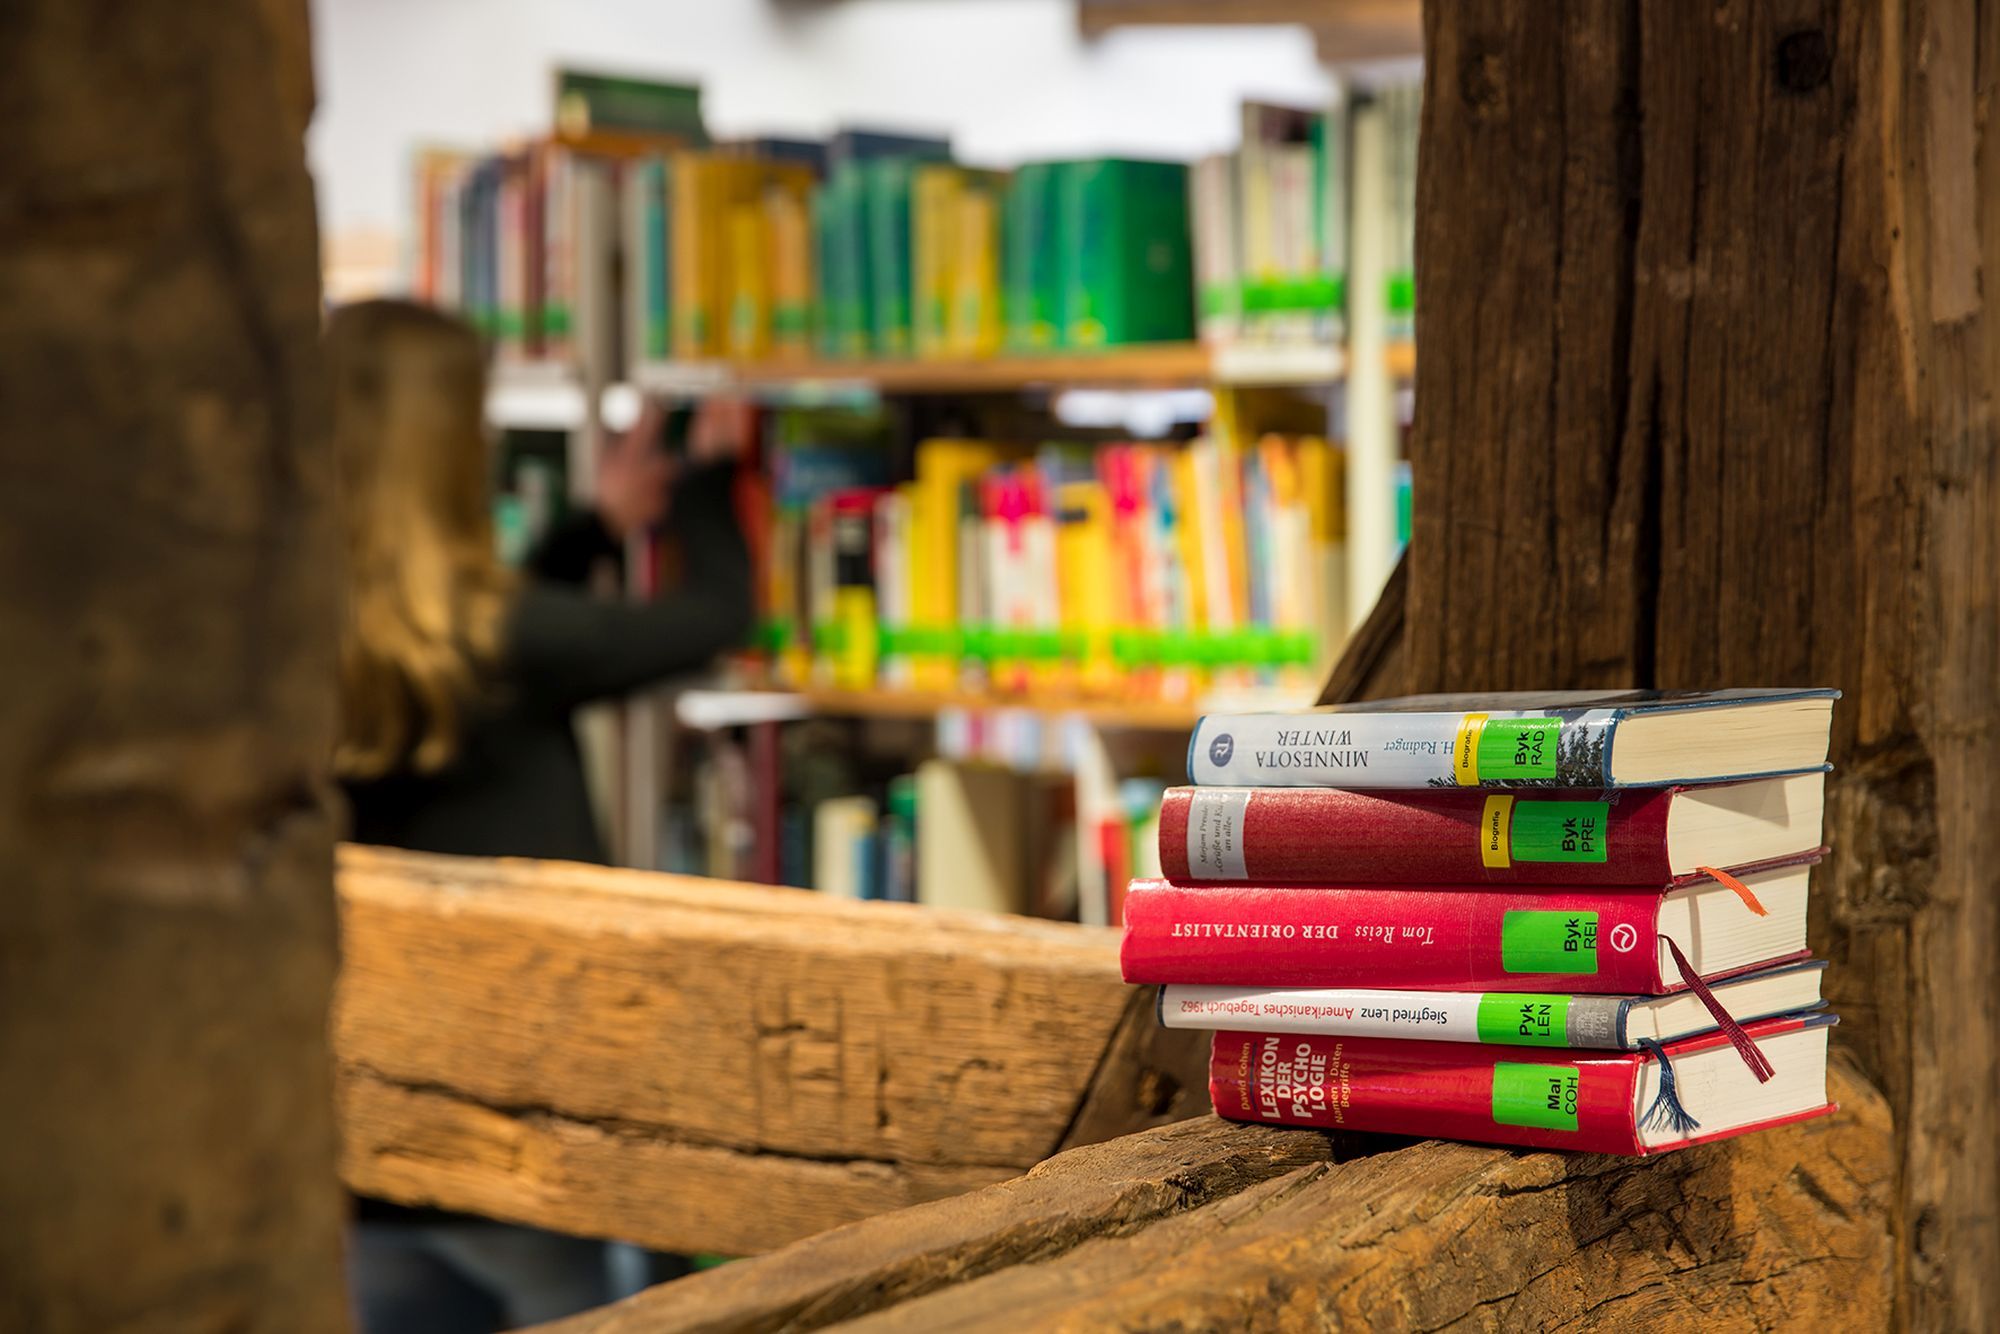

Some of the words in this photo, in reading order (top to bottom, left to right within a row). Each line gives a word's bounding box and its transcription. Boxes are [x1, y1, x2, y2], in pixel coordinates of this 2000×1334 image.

[1278, 730, 1353, 746] WINTER
[1384, 737, 1438, 755] Radinger
[1440, 740, 1455, 755] H.
[1462, 729, 1474, 768] Biografie
[1515, 731, 1531, 766] Byk
[1531, 730, 1546, 766] RAD
[1255, 751, 1369, 768] MINNESOTA
[1213, 819, 1222, 838] und
[1225, 837, 1233, 852] an
[1491, 810, 1501, 851] Biografie
[1562, 817, 1581, 852] Byk
[1581, 817, 1596, 853] PRE
[1171, 923, 1295, 939] ORIENTALIST
[1302, 925, 1339, 940] DER
[1355, 926, 1395, 944] Reiss
[1402, 926, 1435, 946] Tom
[1564, 918, 1582, 952] Byk
[1584, 921, 1597, 950] REI
[1180, 1000, 1204, 1014] 1962
[1206, 1001, 1261, 1017] Tagebuch
[1263, 1003, 1354, 1020] Amerikanisches
[1361, 1007, 1389, 1021] Lenz
[1392, 1008, 1448, 1025] Siegfried
[1519, 1003, 1535, 1036] Pyk
[1537, 1004, 1552, 1037] LEN
[1238, 1042, 1251, 1077] Cohen
[1329, 1043, 1344, 1076] Daten
[1260, 1037, 1281, 1118] LEXIKON
[1276, 1062, 1292, 1099] DER
[1291, 1043, 1313, 1118] PSYCHO
[1309, 1054, 1327, 1111] LOGIE
[1340, 1062, 1352, 1108] Begriffe
[1238, 1080, 1251, 1111] David
[1331, 1086, 1345, 1123] Namen
[1547, 1078, 1562, 1110] Mal
[1564, 1076, 1579, 1115] COH
